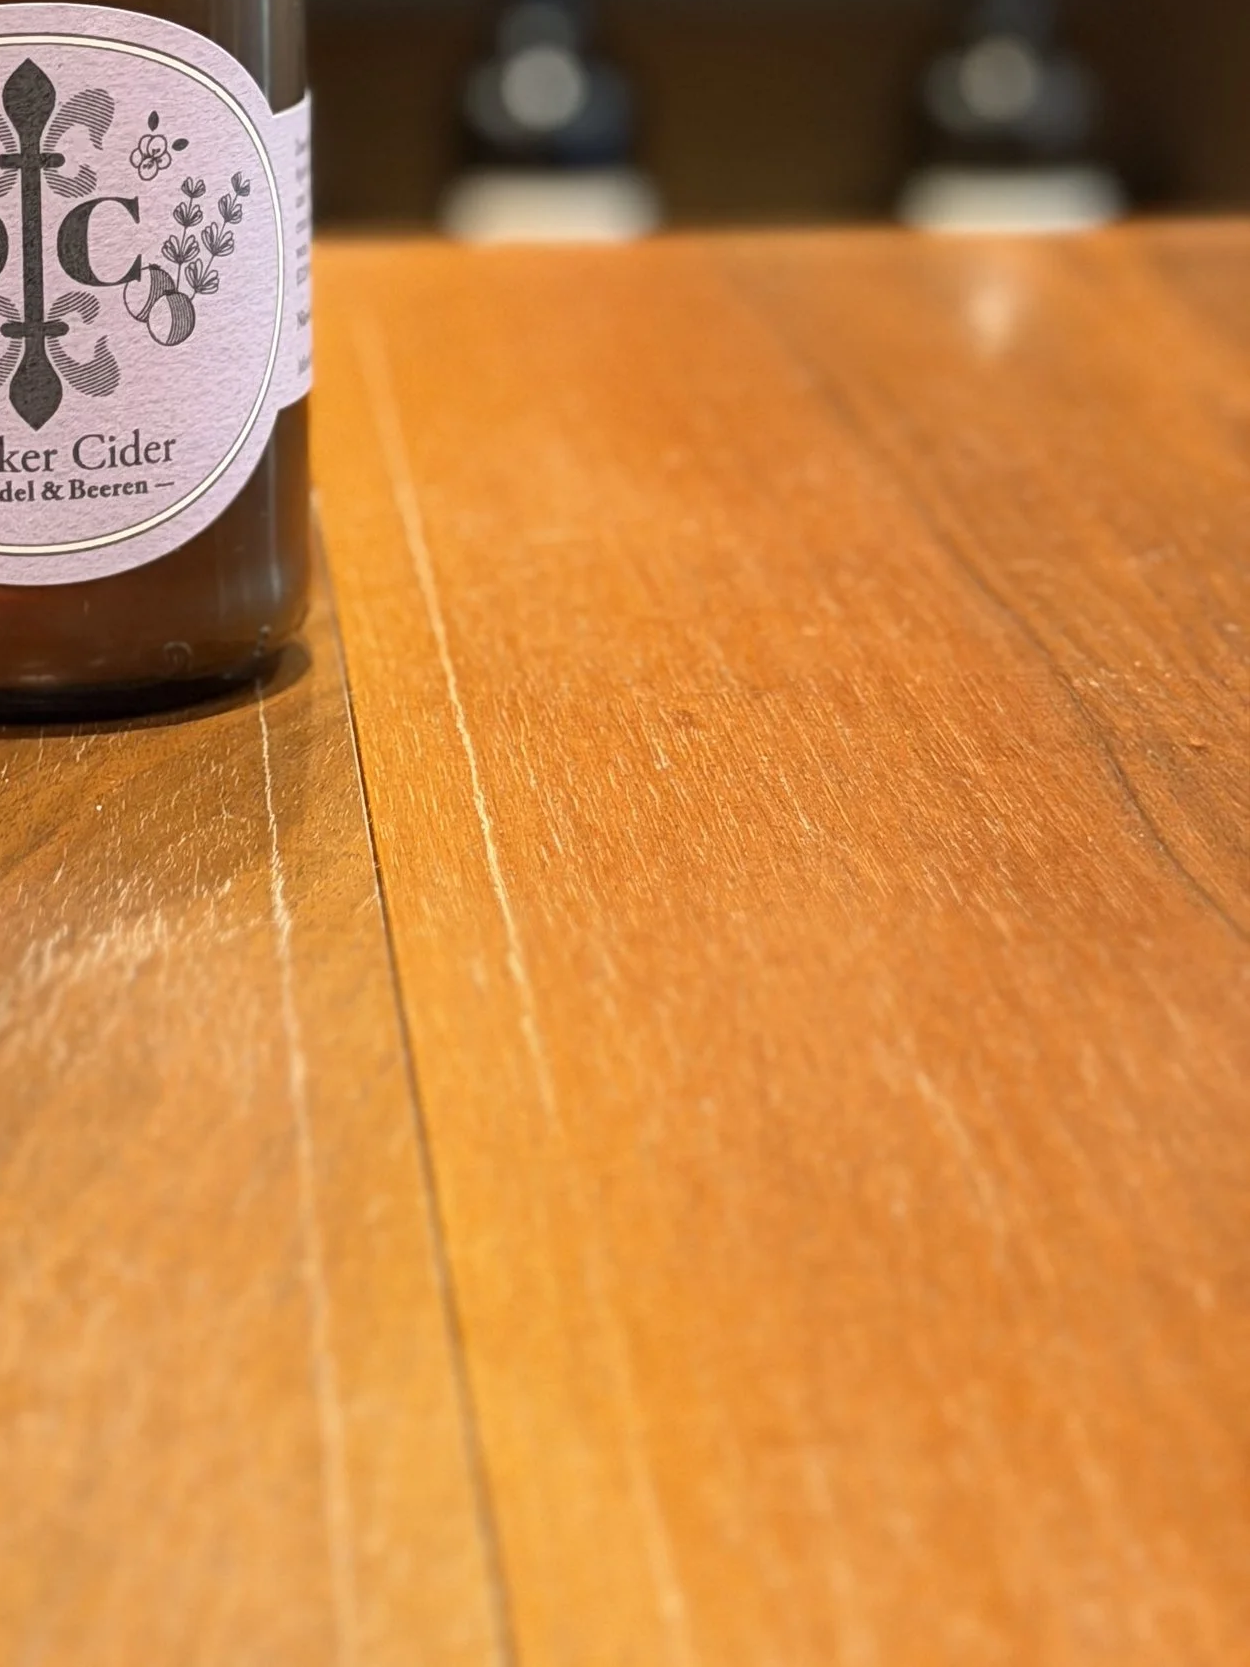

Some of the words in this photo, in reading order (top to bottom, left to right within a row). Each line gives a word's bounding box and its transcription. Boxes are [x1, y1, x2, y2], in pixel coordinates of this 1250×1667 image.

[71, 428, 177, 471] Cider
[41, 480, 65, 501] &
[68, 479, 149, 500] Beeren
